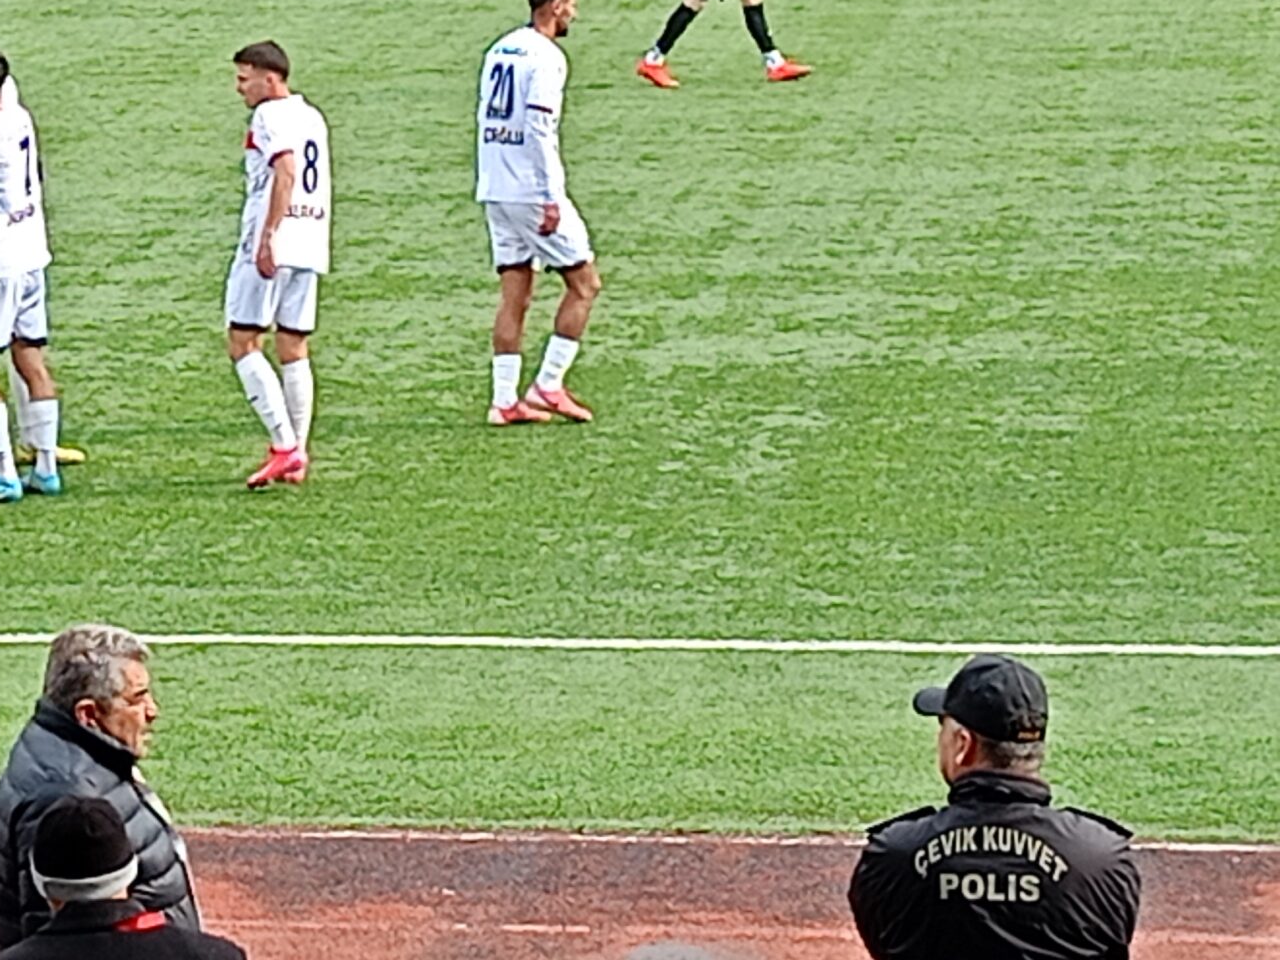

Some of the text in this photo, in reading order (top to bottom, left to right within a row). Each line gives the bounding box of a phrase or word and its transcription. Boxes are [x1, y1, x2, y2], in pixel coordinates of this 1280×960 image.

[486, 61, 515, 120] 20
[302, 139, 319, 194] 8
[982, 825, 1069, 882] KUVVET
